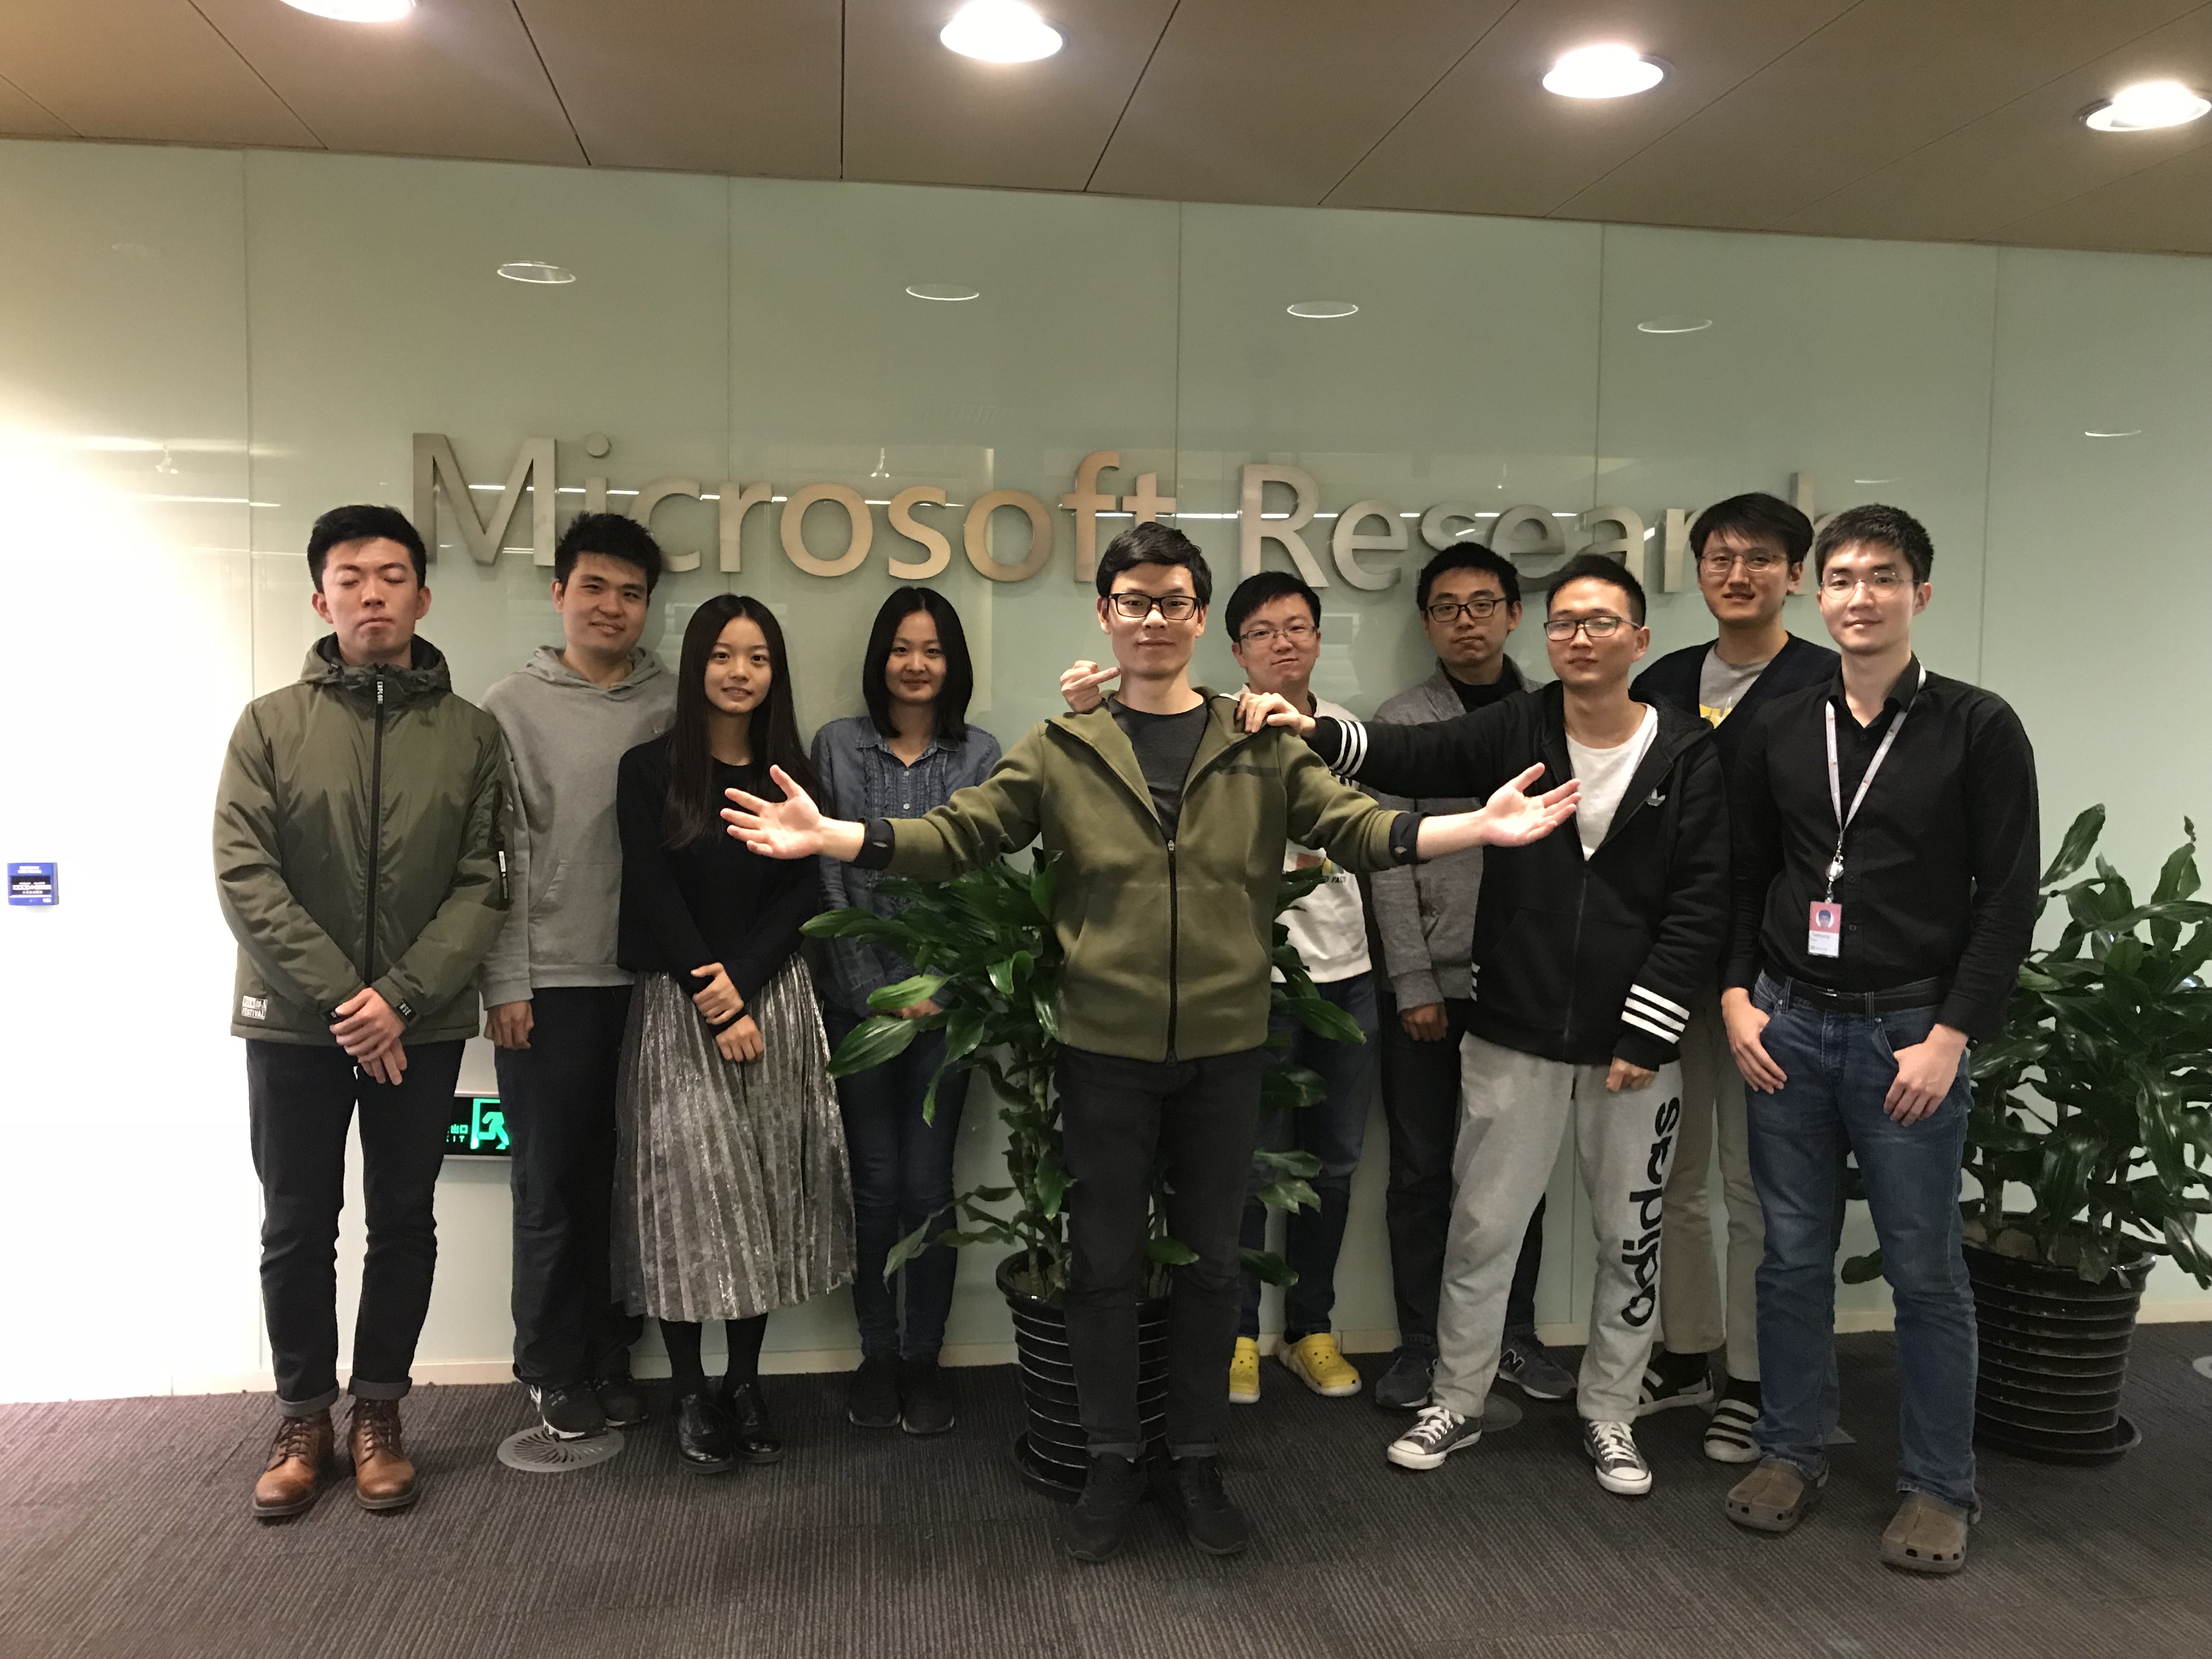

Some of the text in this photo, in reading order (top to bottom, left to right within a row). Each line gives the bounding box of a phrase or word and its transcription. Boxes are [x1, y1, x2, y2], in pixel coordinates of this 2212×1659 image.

[412, 432, 1832, 595] Microsoft Resear
[242, 1007, 264, 1019] FESTIVAL
[399, 1000, 412, 1016] RSE
[447, 1124, 469, 1135] 出口
[1621, 1096, 1680, 1328] adidas
